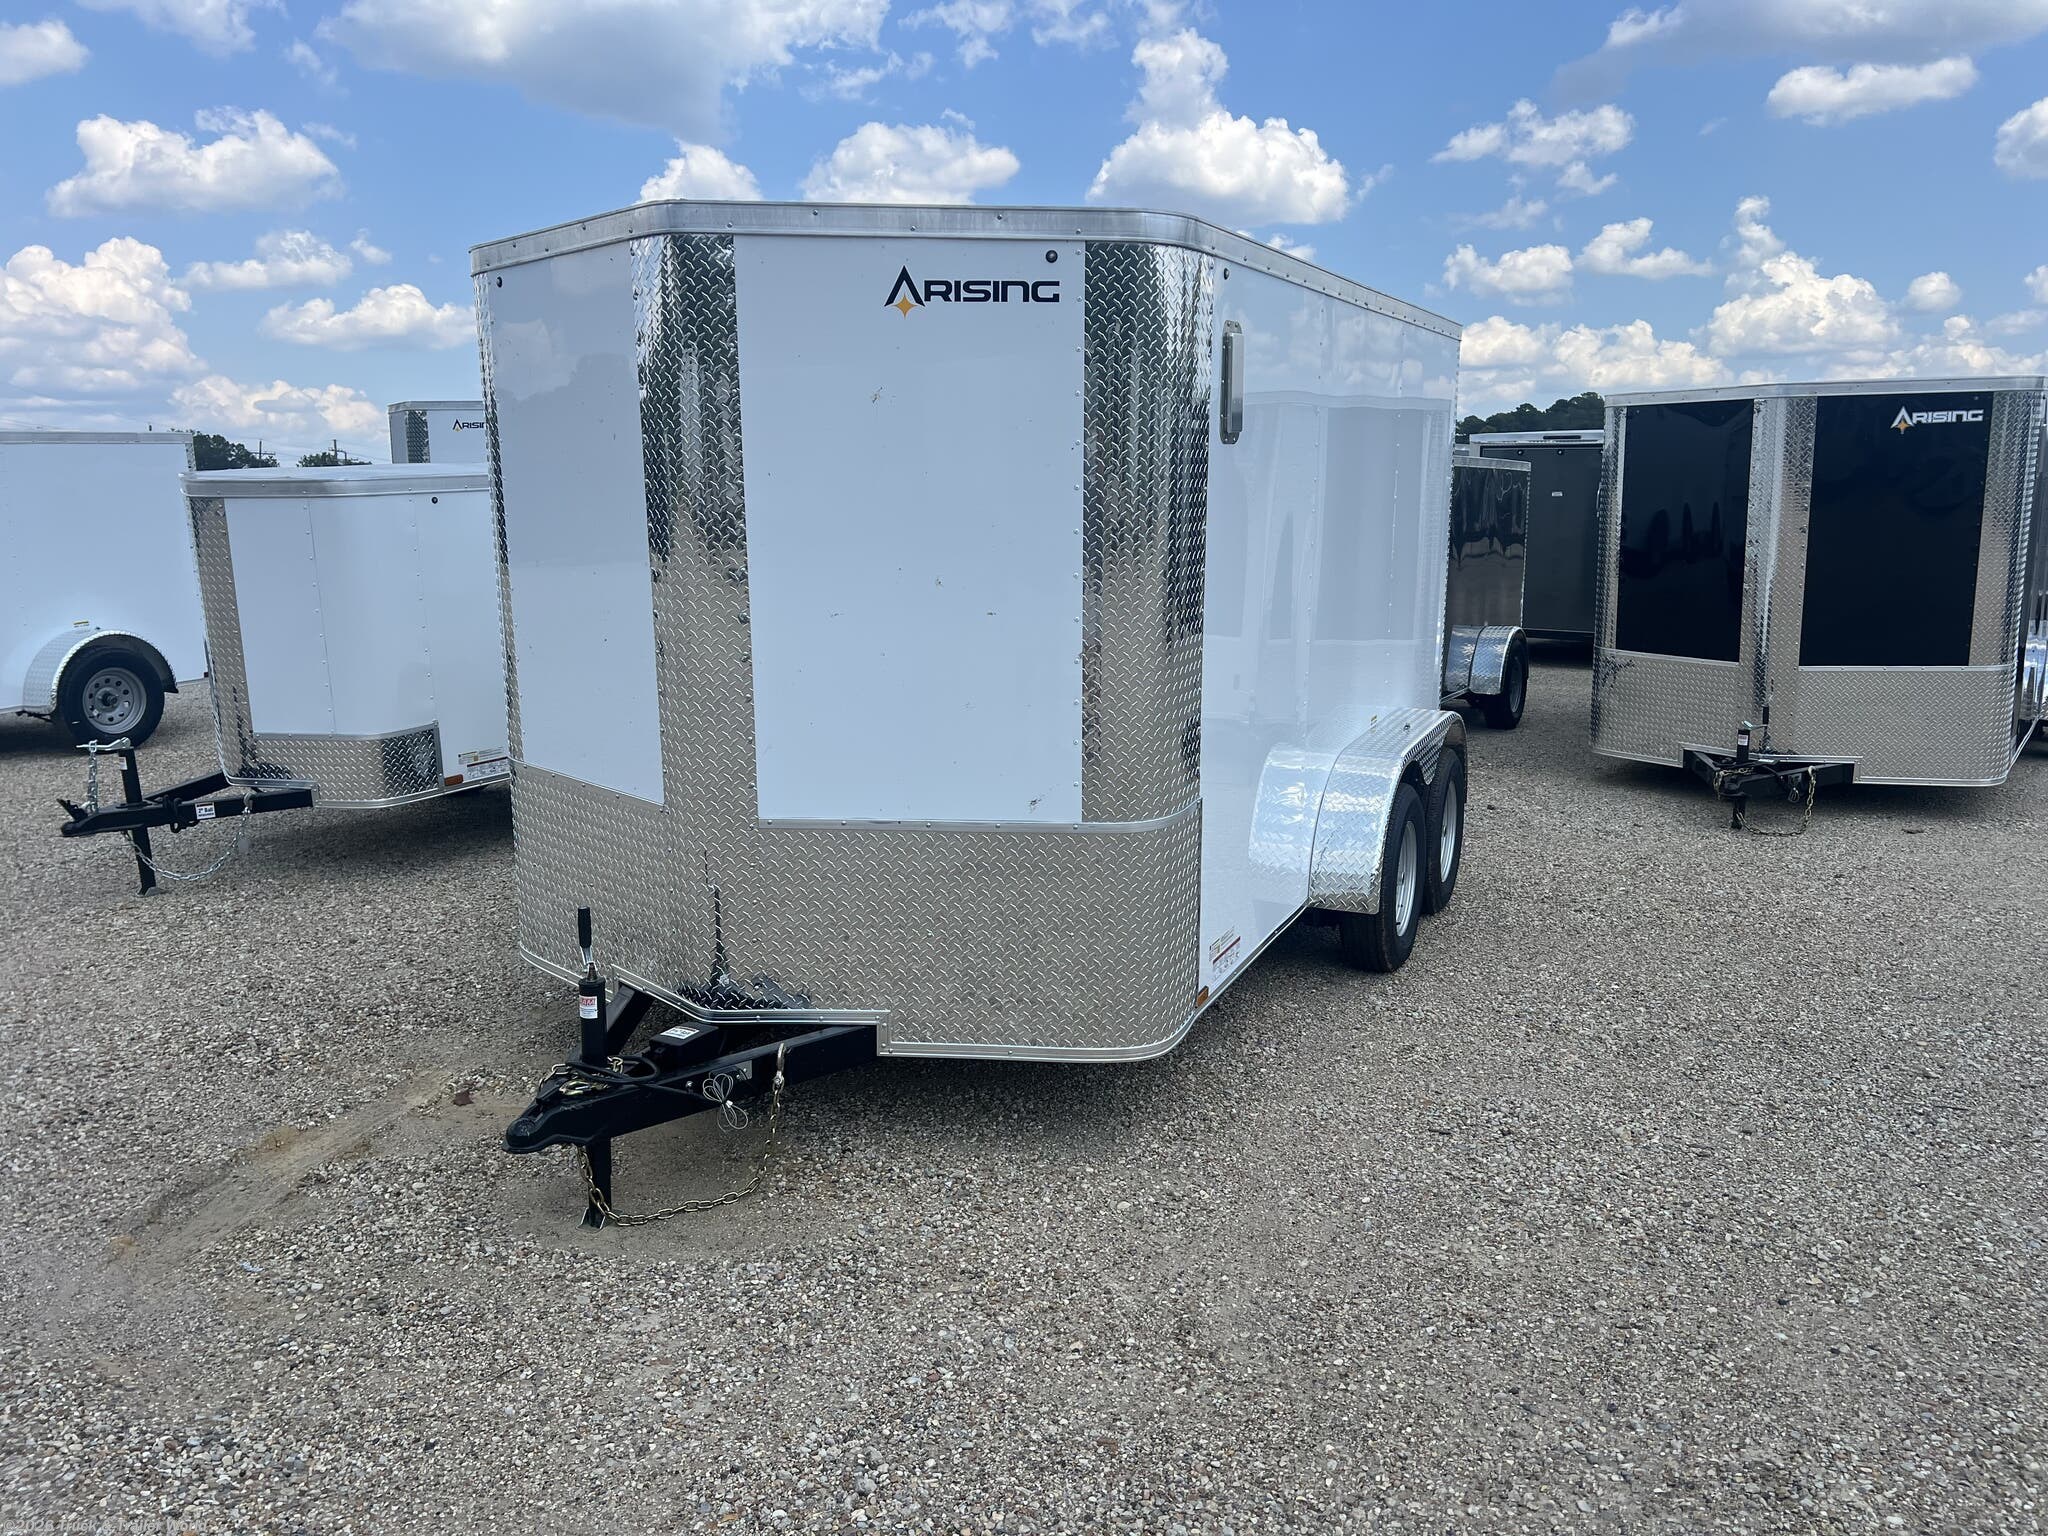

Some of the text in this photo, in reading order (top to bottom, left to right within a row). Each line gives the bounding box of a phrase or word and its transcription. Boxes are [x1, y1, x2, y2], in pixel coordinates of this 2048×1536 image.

[884, 265, 1061, 309] ARISING
[452, 419, 484, 431] ARISI
[1890, 405, 1984, 430] ARISING
